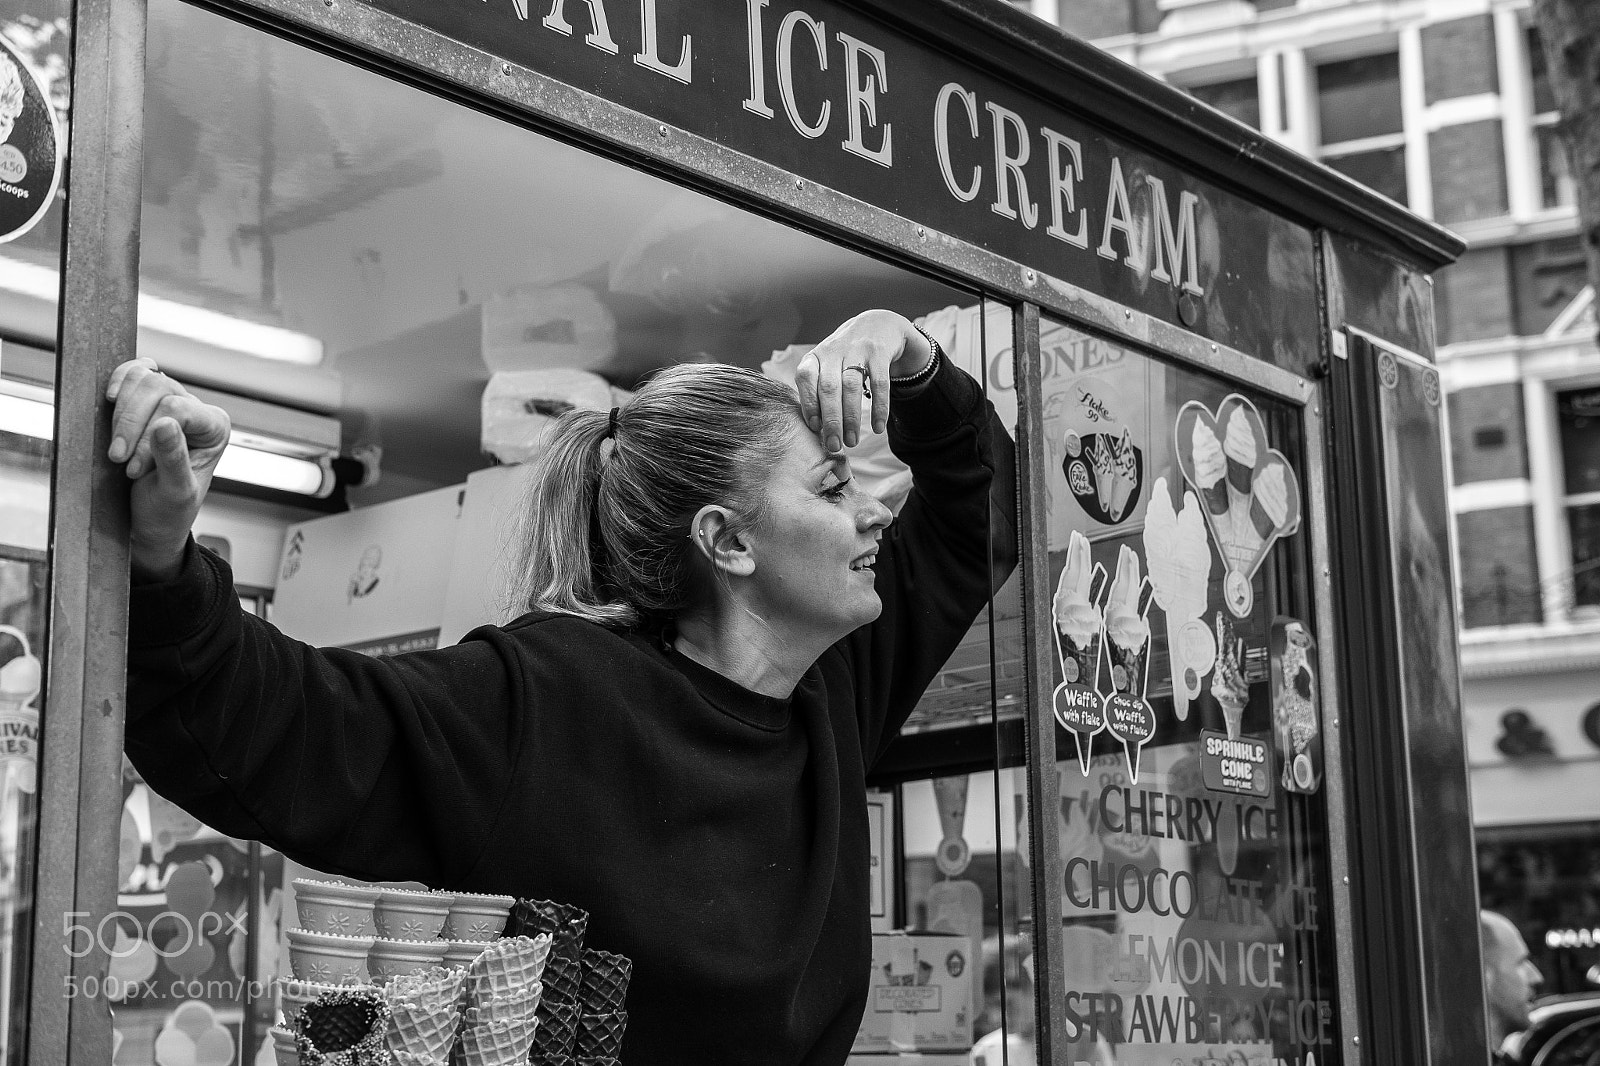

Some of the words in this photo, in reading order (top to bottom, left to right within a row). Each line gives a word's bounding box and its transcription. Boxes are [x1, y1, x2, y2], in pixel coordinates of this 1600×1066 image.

[742, 0, 893, 169] ICE
[934, 82, 1204, 298] CREAM
[0, 182, 29, 199] coops
[1064, 688, 1098, 708] Waffle
[1132, 700, 1144, 711] dip
[1063, 708, 1080, 724] with
[1081, 711, 1101, 727] flake
[1114, 708, 1146, 724] Waffle
[1112, 721, 1129, 733] with
[1129, 724, 1148, 737] flake
[1206, 737, 1265, 763] SPRINKLE
[1221, 759, 1253, 780] CONE
[1099, 784, 1222, 843] CHERRY
[1235, 803, 1278, 841] ICE
[1275, 883, 1319, 931] ICE
[1237, 941, 1284, 988] ICE
[1064, 990, 1275, 1044] STRAWBERRY
[1289, 999, 1333, 1045] ICE
